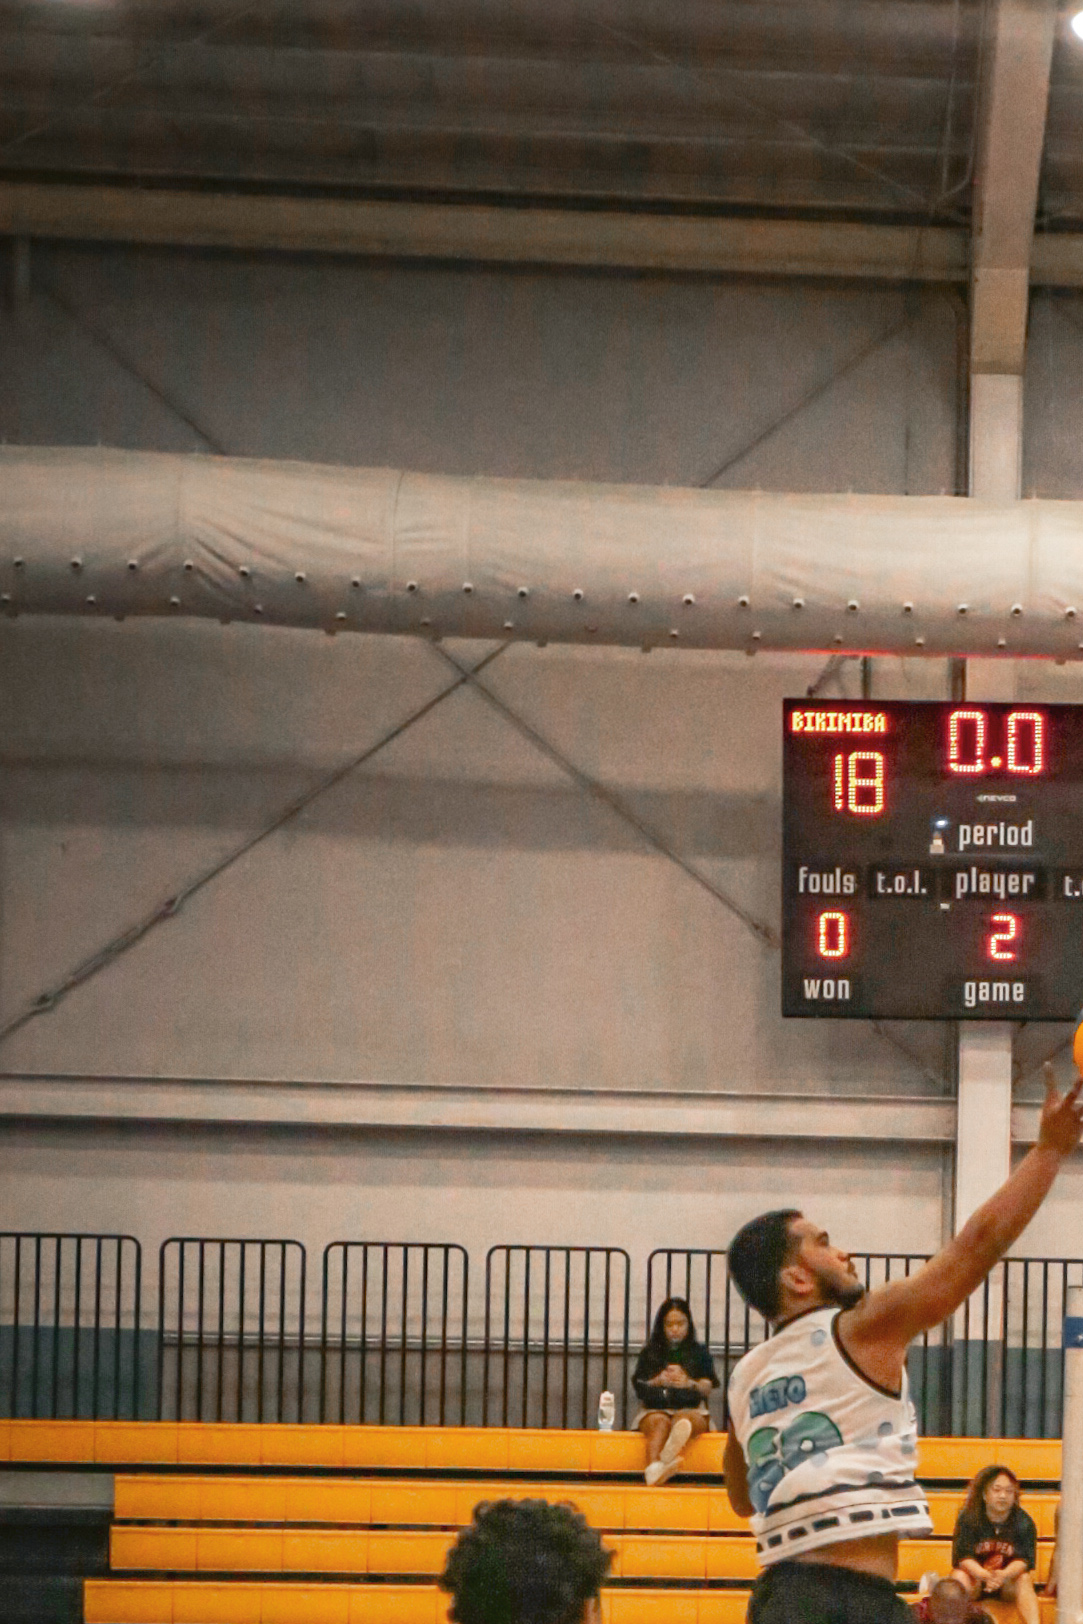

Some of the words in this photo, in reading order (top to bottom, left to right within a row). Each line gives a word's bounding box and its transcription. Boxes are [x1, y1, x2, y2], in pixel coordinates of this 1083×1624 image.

[950, 711, 1041, 773] 0.0
[835, 752, 883, 813] 18
[959, 820, 1033, 851] period
[798, 866, 855, 893] fouls
[876, 870, 927, 893] t.o.l.
[956, 867, 1035, 899] player
[819, 912, 845, 957] 0
[990, 915, 1015, 959] 2
[803, 979, 851, 1000] won
[964, 982, 1024, 1007] game
